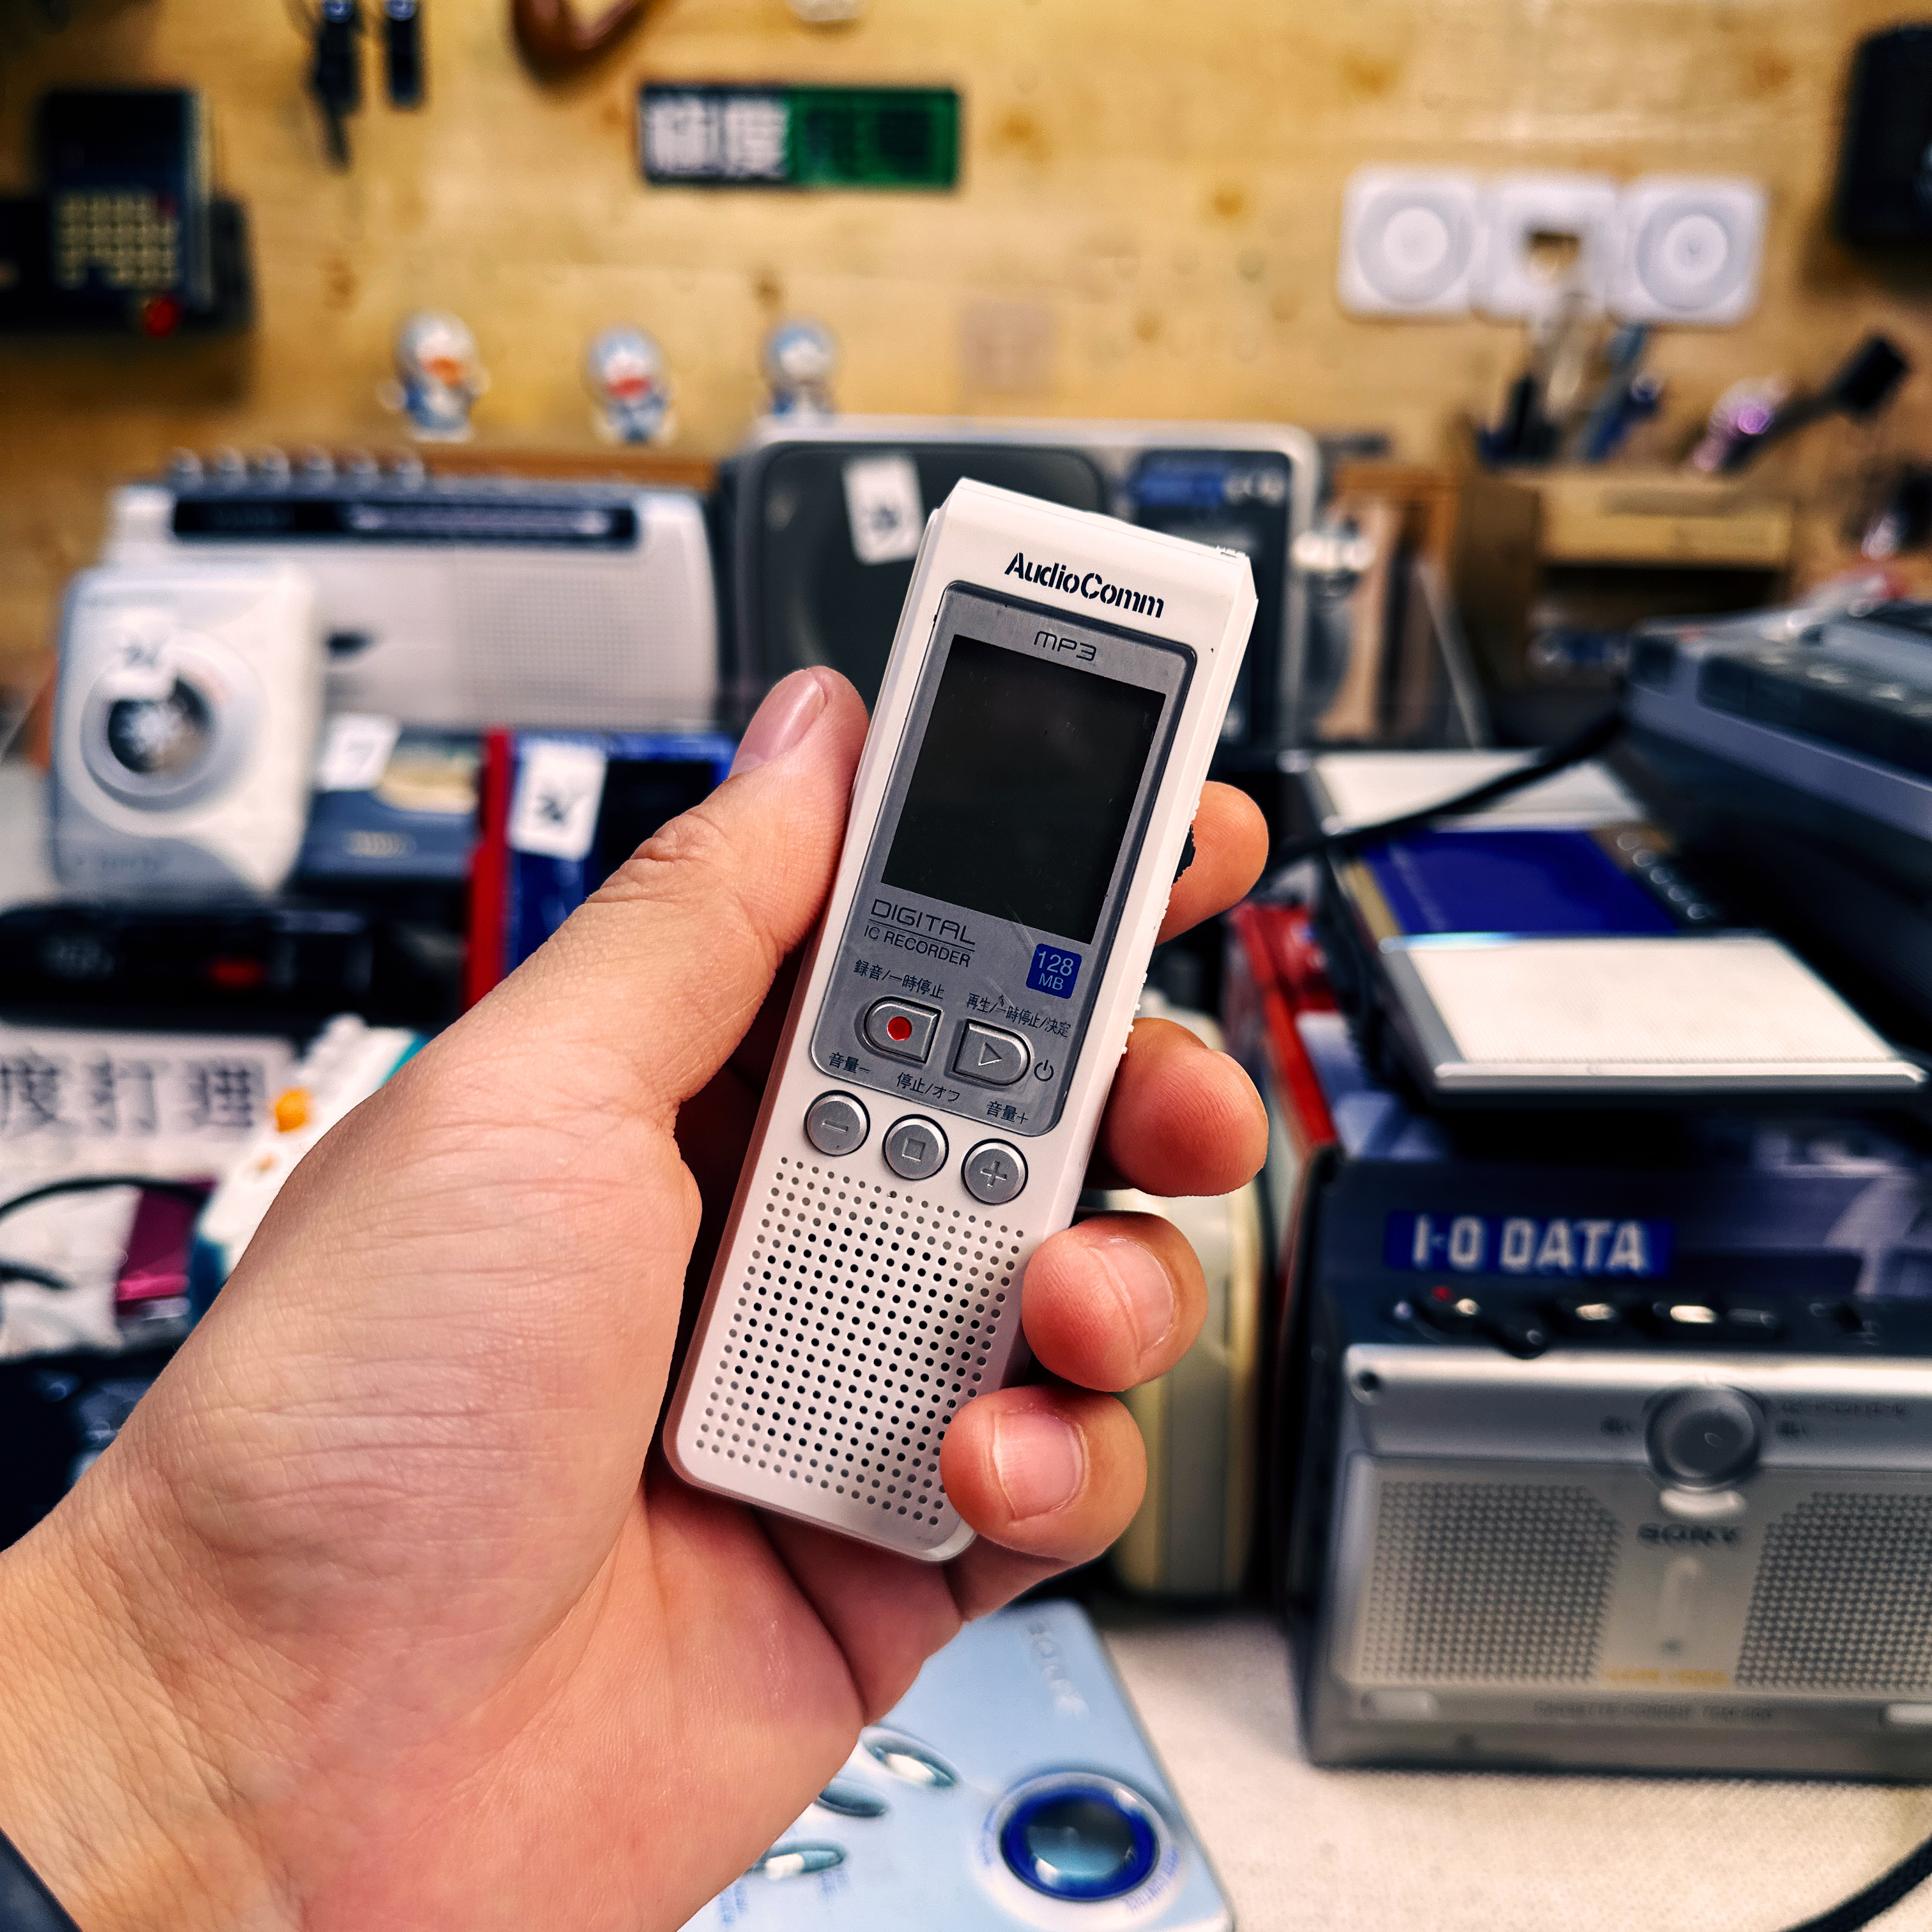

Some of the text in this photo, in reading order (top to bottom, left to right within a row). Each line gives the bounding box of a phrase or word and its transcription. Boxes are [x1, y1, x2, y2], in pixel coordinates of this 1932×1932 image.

[1004, 553, 1164, 618] AudioComm
[1034, 631, 1097, 661] MP3
[870, 898, 976, 946] DIGITAL
[864, 924, 971, 968] IC RECORDER
[1038, 950, 1075, 977] 128
[1038, 972, 1064, 992] MB
[896, 1071, 961, 1103] 停止/オフ
[1498, 1218, 1648, 1272] DATA
